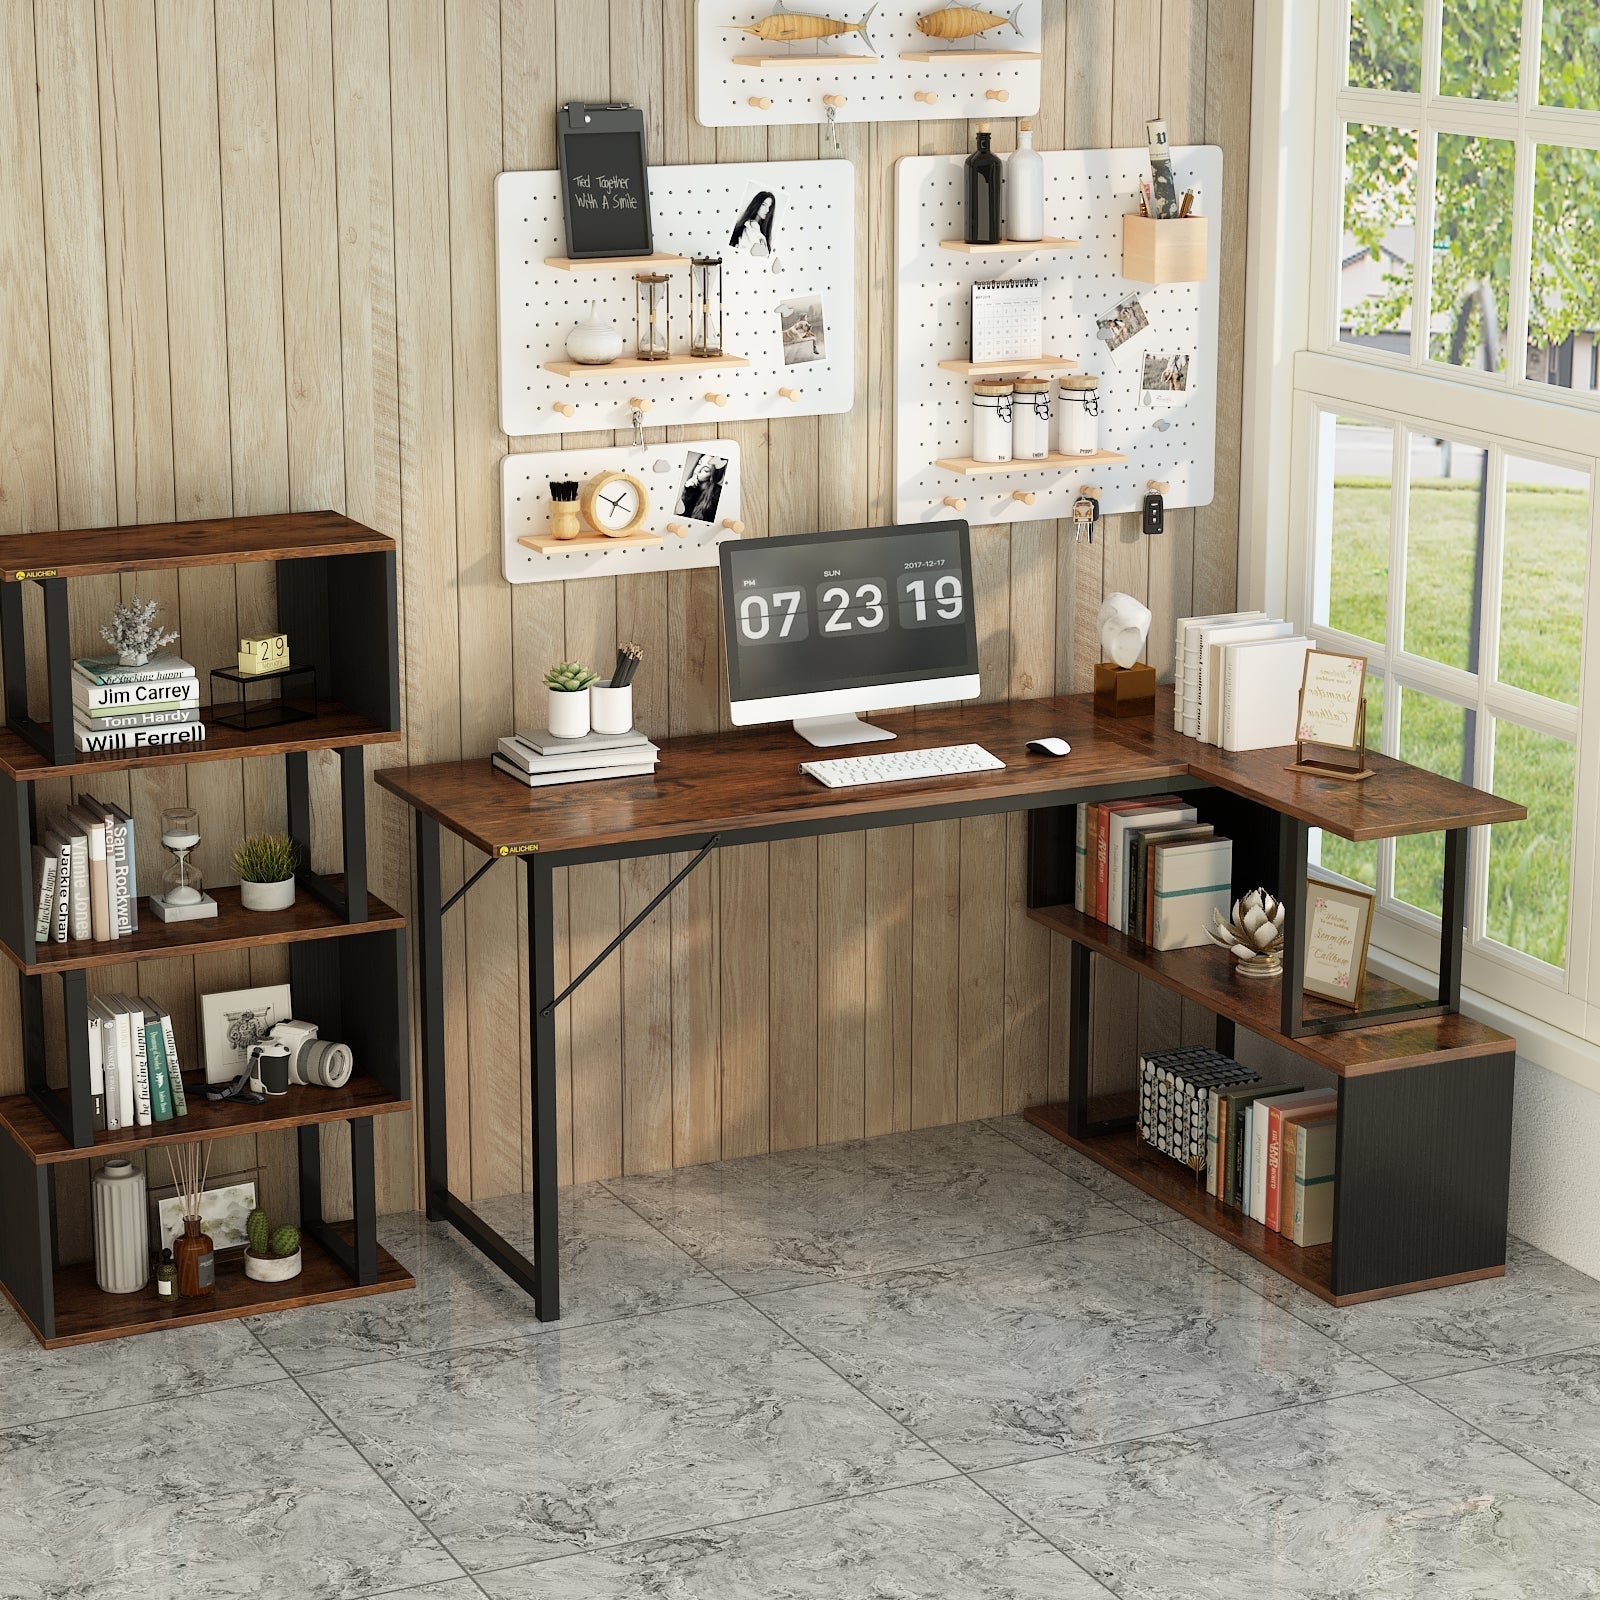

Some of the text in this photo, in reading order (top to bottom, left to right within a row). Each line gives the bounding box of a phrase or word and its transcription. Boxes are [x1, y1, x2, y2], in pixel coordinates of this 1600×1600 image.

[573, 175, 630, 194] Tied Together
[575, 193, 638, 209] With A Smile
[26, 570, 57, 578] AILICHEN
[904, 559, 945, 570] 2017-12-17
[740, 575, 963, 640] 07 23 19
[98, 685, 191, 705] Jim Carrey
[101, 710, 190, 728] Tom Hardy
[86, 726, 202, 751] Will Ferrell
[106, 819, 114, 853] Arch
[510, 844, 538, 854] AILICHEN
[72, 840, 89, 939] Vinnie Jones
[114, 826, 132, 934] Sam Rockwell
[58, 848, 70, 940] Jackie Chan
[38, 894, 54, 924] fucking
[37, 926, 48, 935] be
[136, 1026, 150, 1116] be fucking happy
[166, 1029, 184, 1106] be fucking happy
